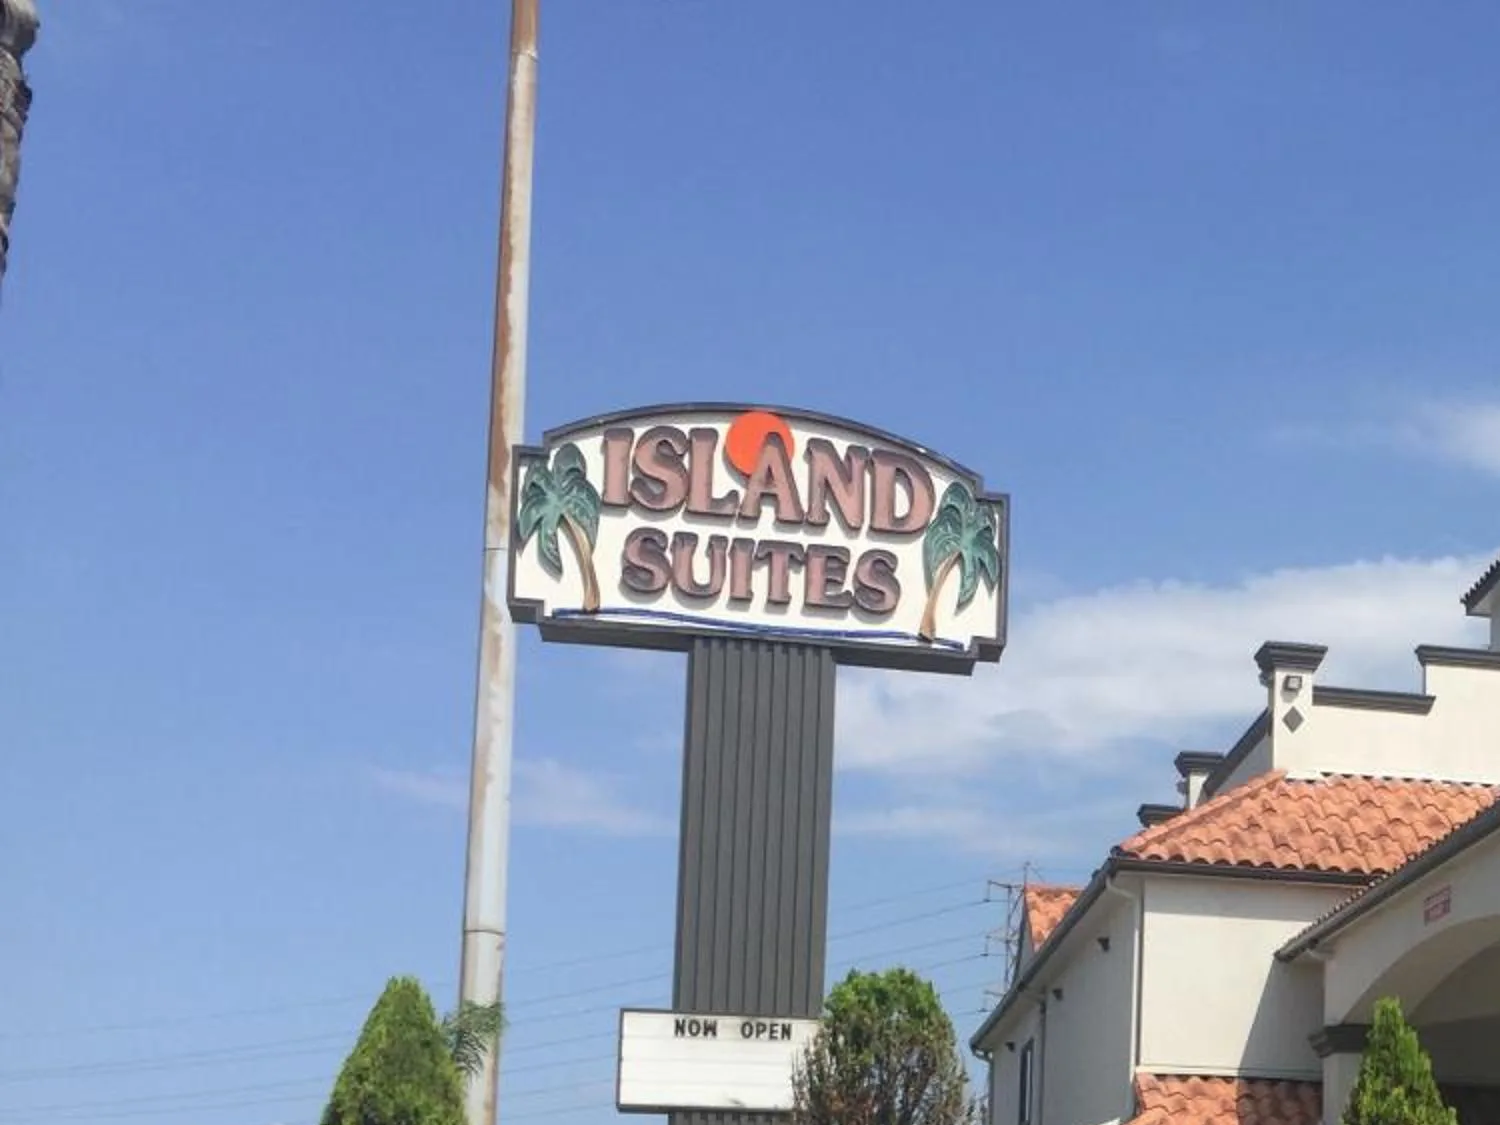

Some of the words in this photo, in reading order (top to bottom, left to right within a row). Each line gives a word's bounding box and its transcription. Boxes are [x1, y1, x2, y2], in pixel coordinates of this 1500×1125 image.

[601, 425, 937, 534] ISLAND
[620, 526, 900, 615] SUITES
[674, 1018, 718, 1038] NOW
[740, 1021, 792, 1041] OPEN
